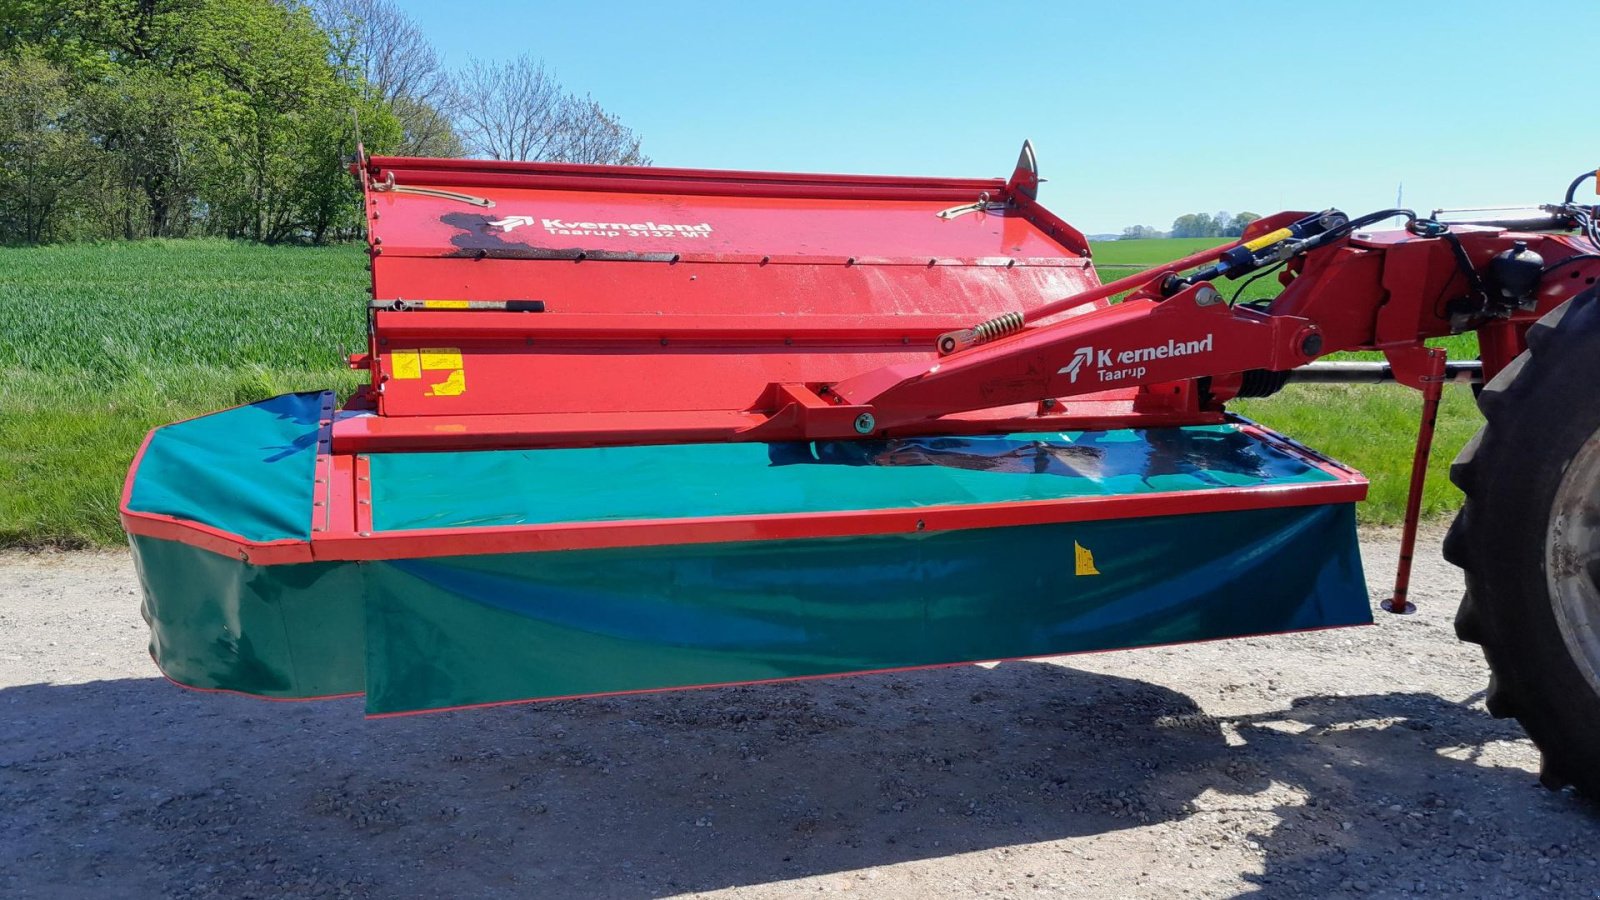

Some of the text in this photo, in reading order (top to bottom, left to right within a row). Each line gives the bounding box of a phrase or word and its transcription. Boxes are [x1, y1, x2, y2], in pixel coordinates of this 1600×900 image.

[541, 218, 713, 232] Kverneland
[544, 227, 620, 238] Taarup
[628, 230, 676, 238] 3132
